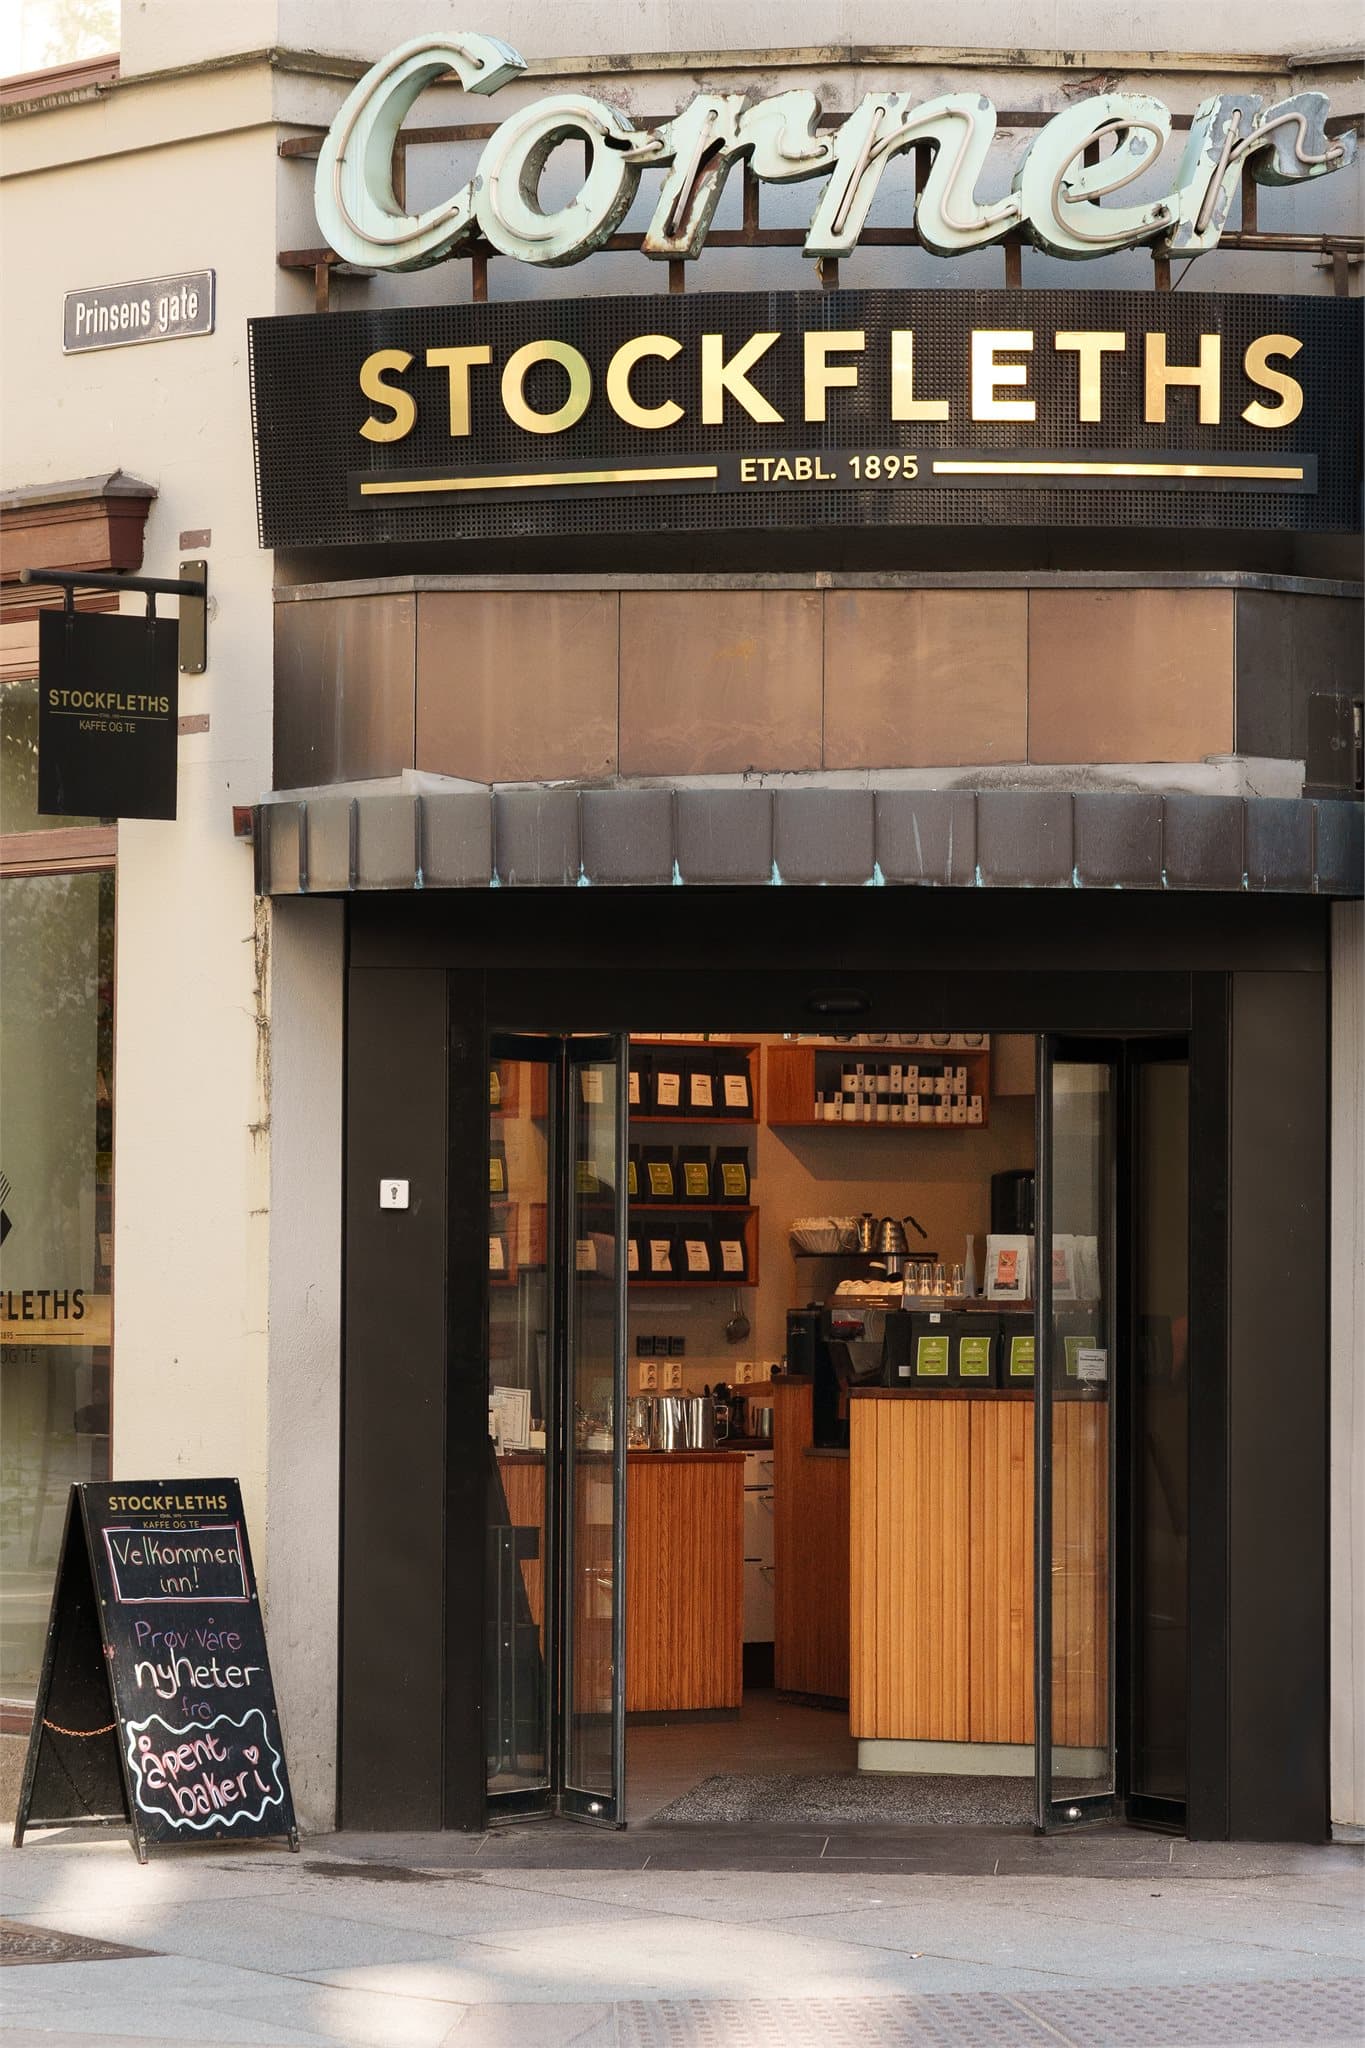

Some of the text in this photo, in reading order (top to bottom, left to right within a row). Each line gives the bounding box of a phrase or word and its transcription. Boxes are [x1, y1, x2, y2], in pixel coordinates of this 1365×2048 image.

[315, 32, 1358, 272] Corner
[76, 286, 198, 336] Prinsens gate
[359, 330, 1304, 442] STOCKFLETHS
[740, 455, 919, 482] ETABL. 1895
[49, 689, 169, 713] STOCKFLETHS
[79, 720, 136, 733] KAFFE OG TE
[108, 1495, 228, 1511] STOCKFLETHS
[143, 1520, 200, 1529] KAFFE OG TE
[112, 1535, 241, 1565] Velkommen
[160, 1566, 199, 1593] inn!
[134, 1621, 188, 1649] Prøv
[134, 1647, 263, 1699] nyheter
[181, 1696, 212, 1720] fra
[138, 1733, 227, 1789] åpent
